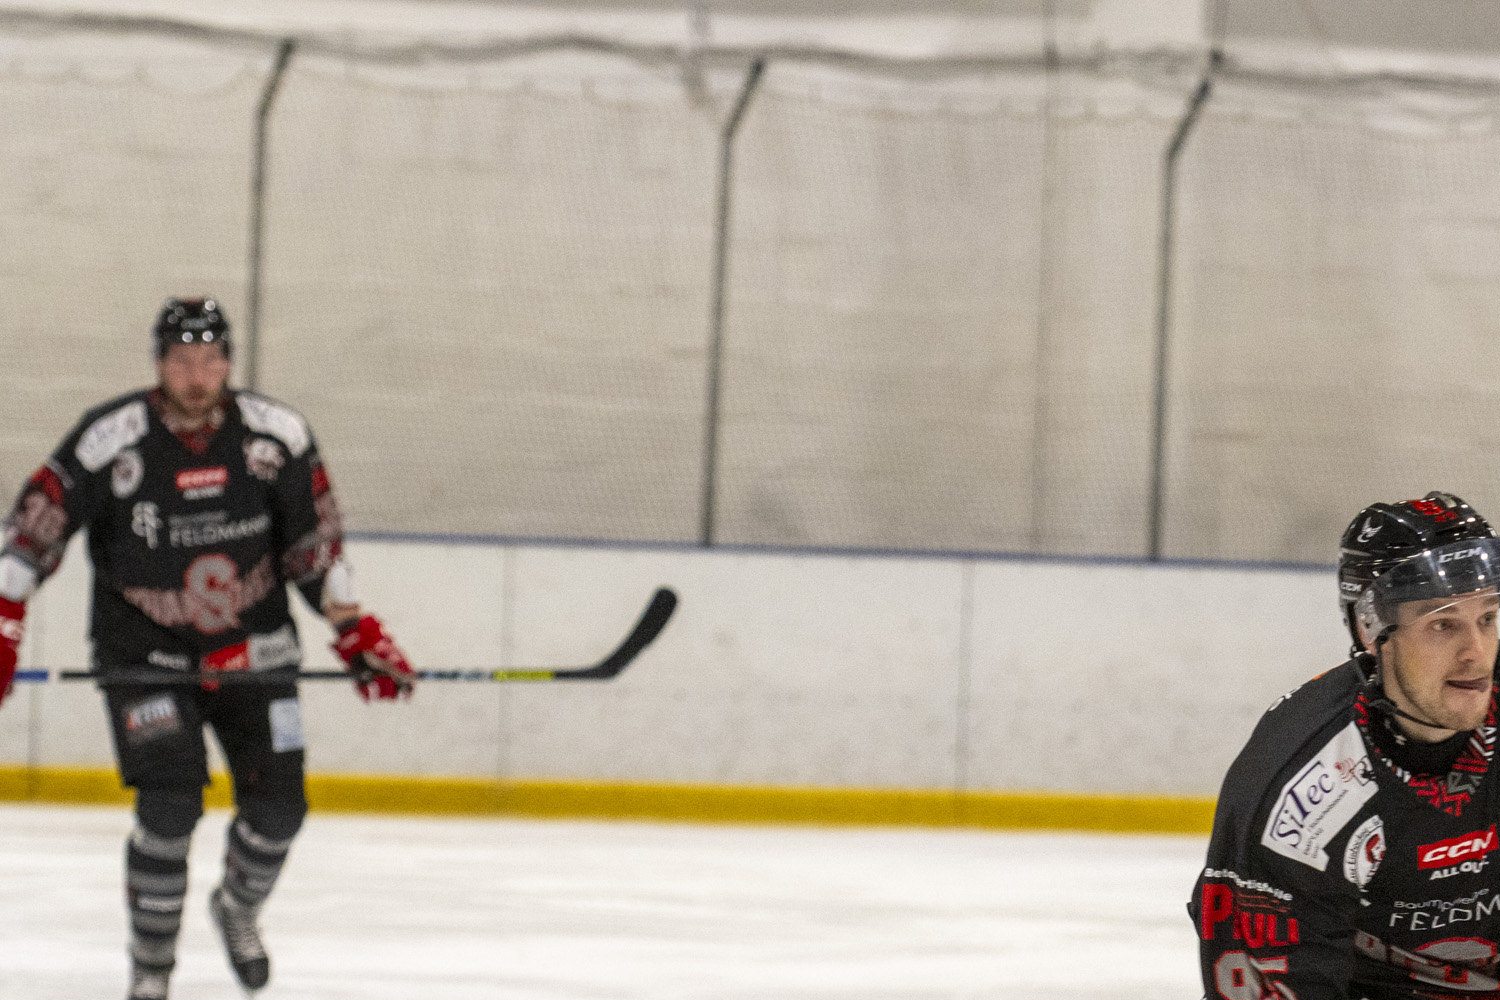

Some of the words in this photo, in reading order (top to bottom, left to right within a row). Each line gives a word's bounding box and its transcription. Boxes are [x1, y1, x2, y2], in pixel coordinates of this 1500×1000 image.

[1438, 547, 1483, 563] CCM
[1341, 582, 1362, 591] CCM
[1270, 761, 1335, 847] SiTec
